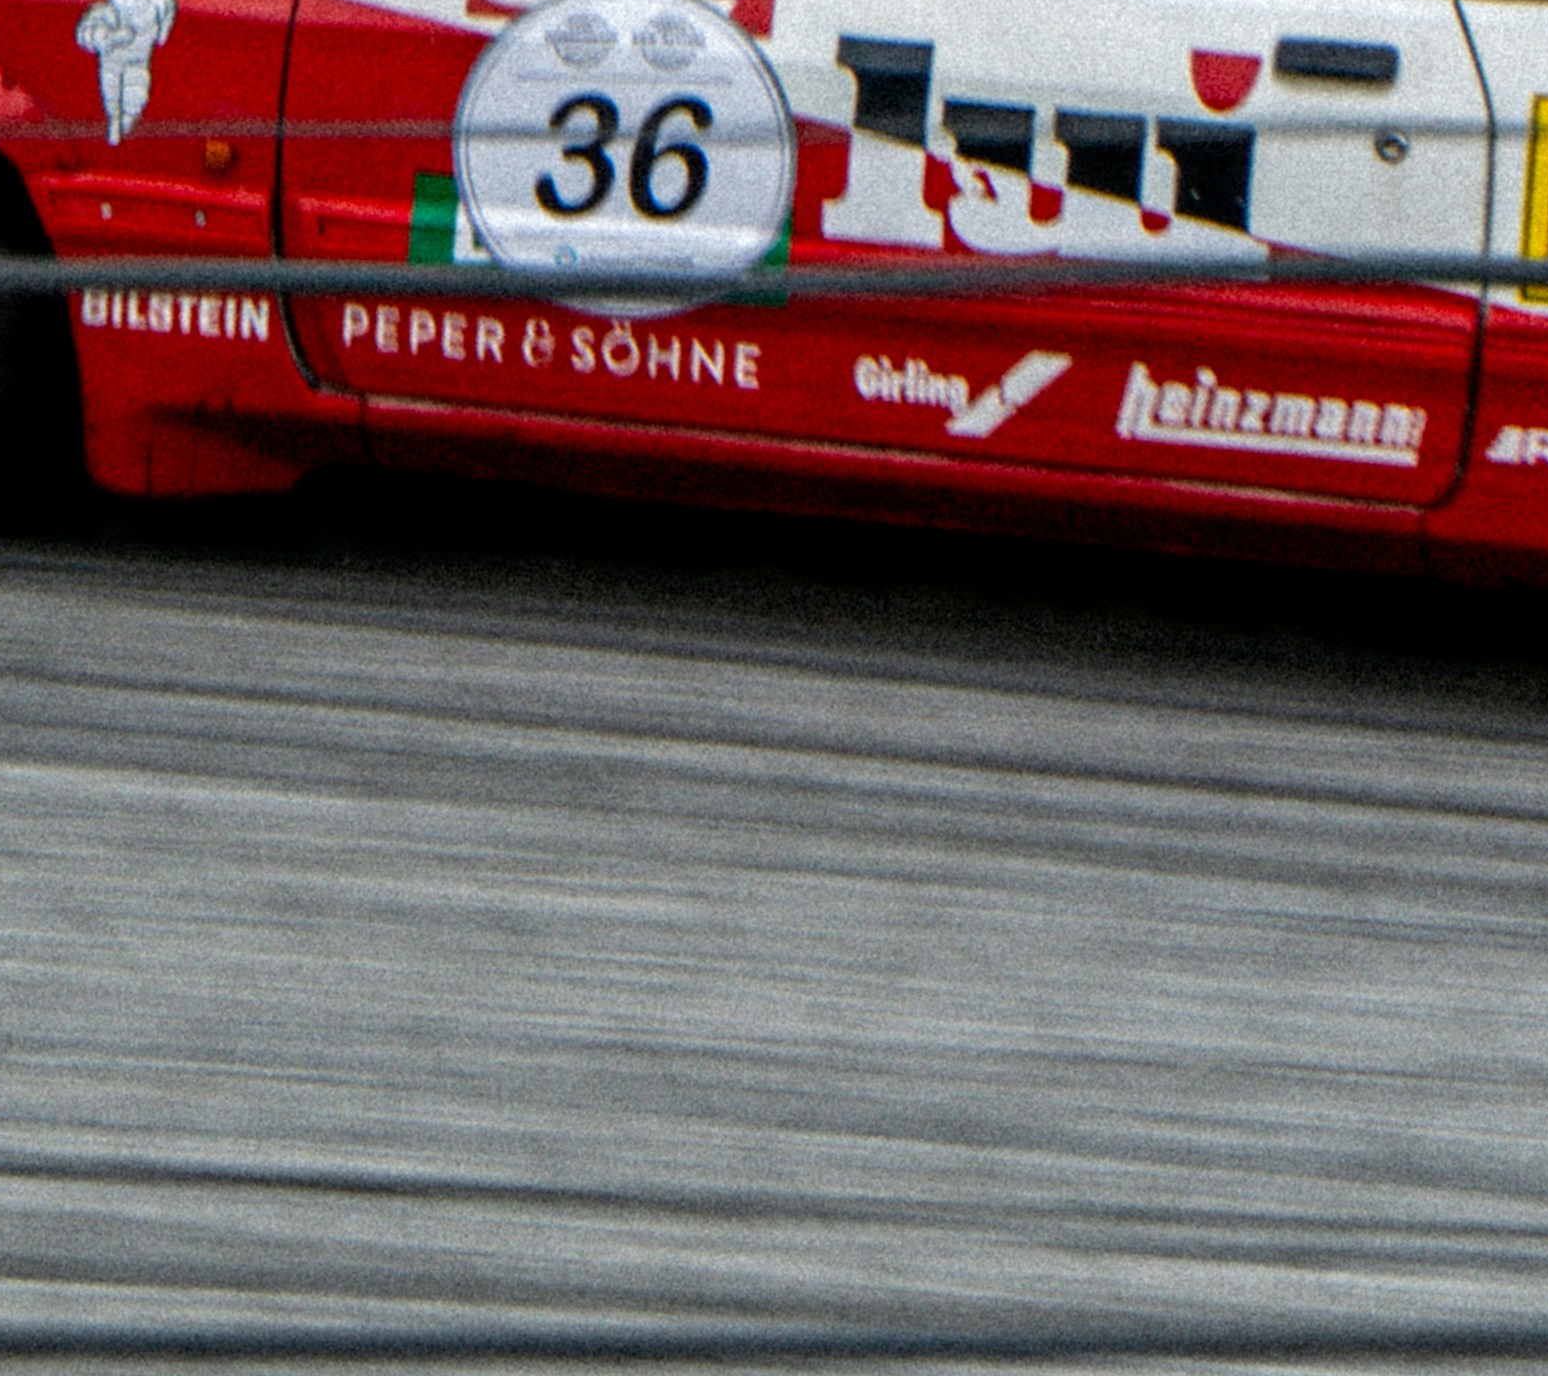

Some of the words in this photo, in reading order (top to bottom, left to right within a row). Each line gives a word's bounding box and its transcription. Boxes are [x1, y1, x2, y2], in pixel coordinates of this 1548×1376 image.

[535, 93, 713, 221] 36
[82, 290, 270, 343] BILSTEIN
[342, 301, 504, 365] PEPER
[570, 318, 764, 391] SÖHNE
[855, 353, 970, 420] Girling
[1116, 361, 1428, 460] heinzmann
